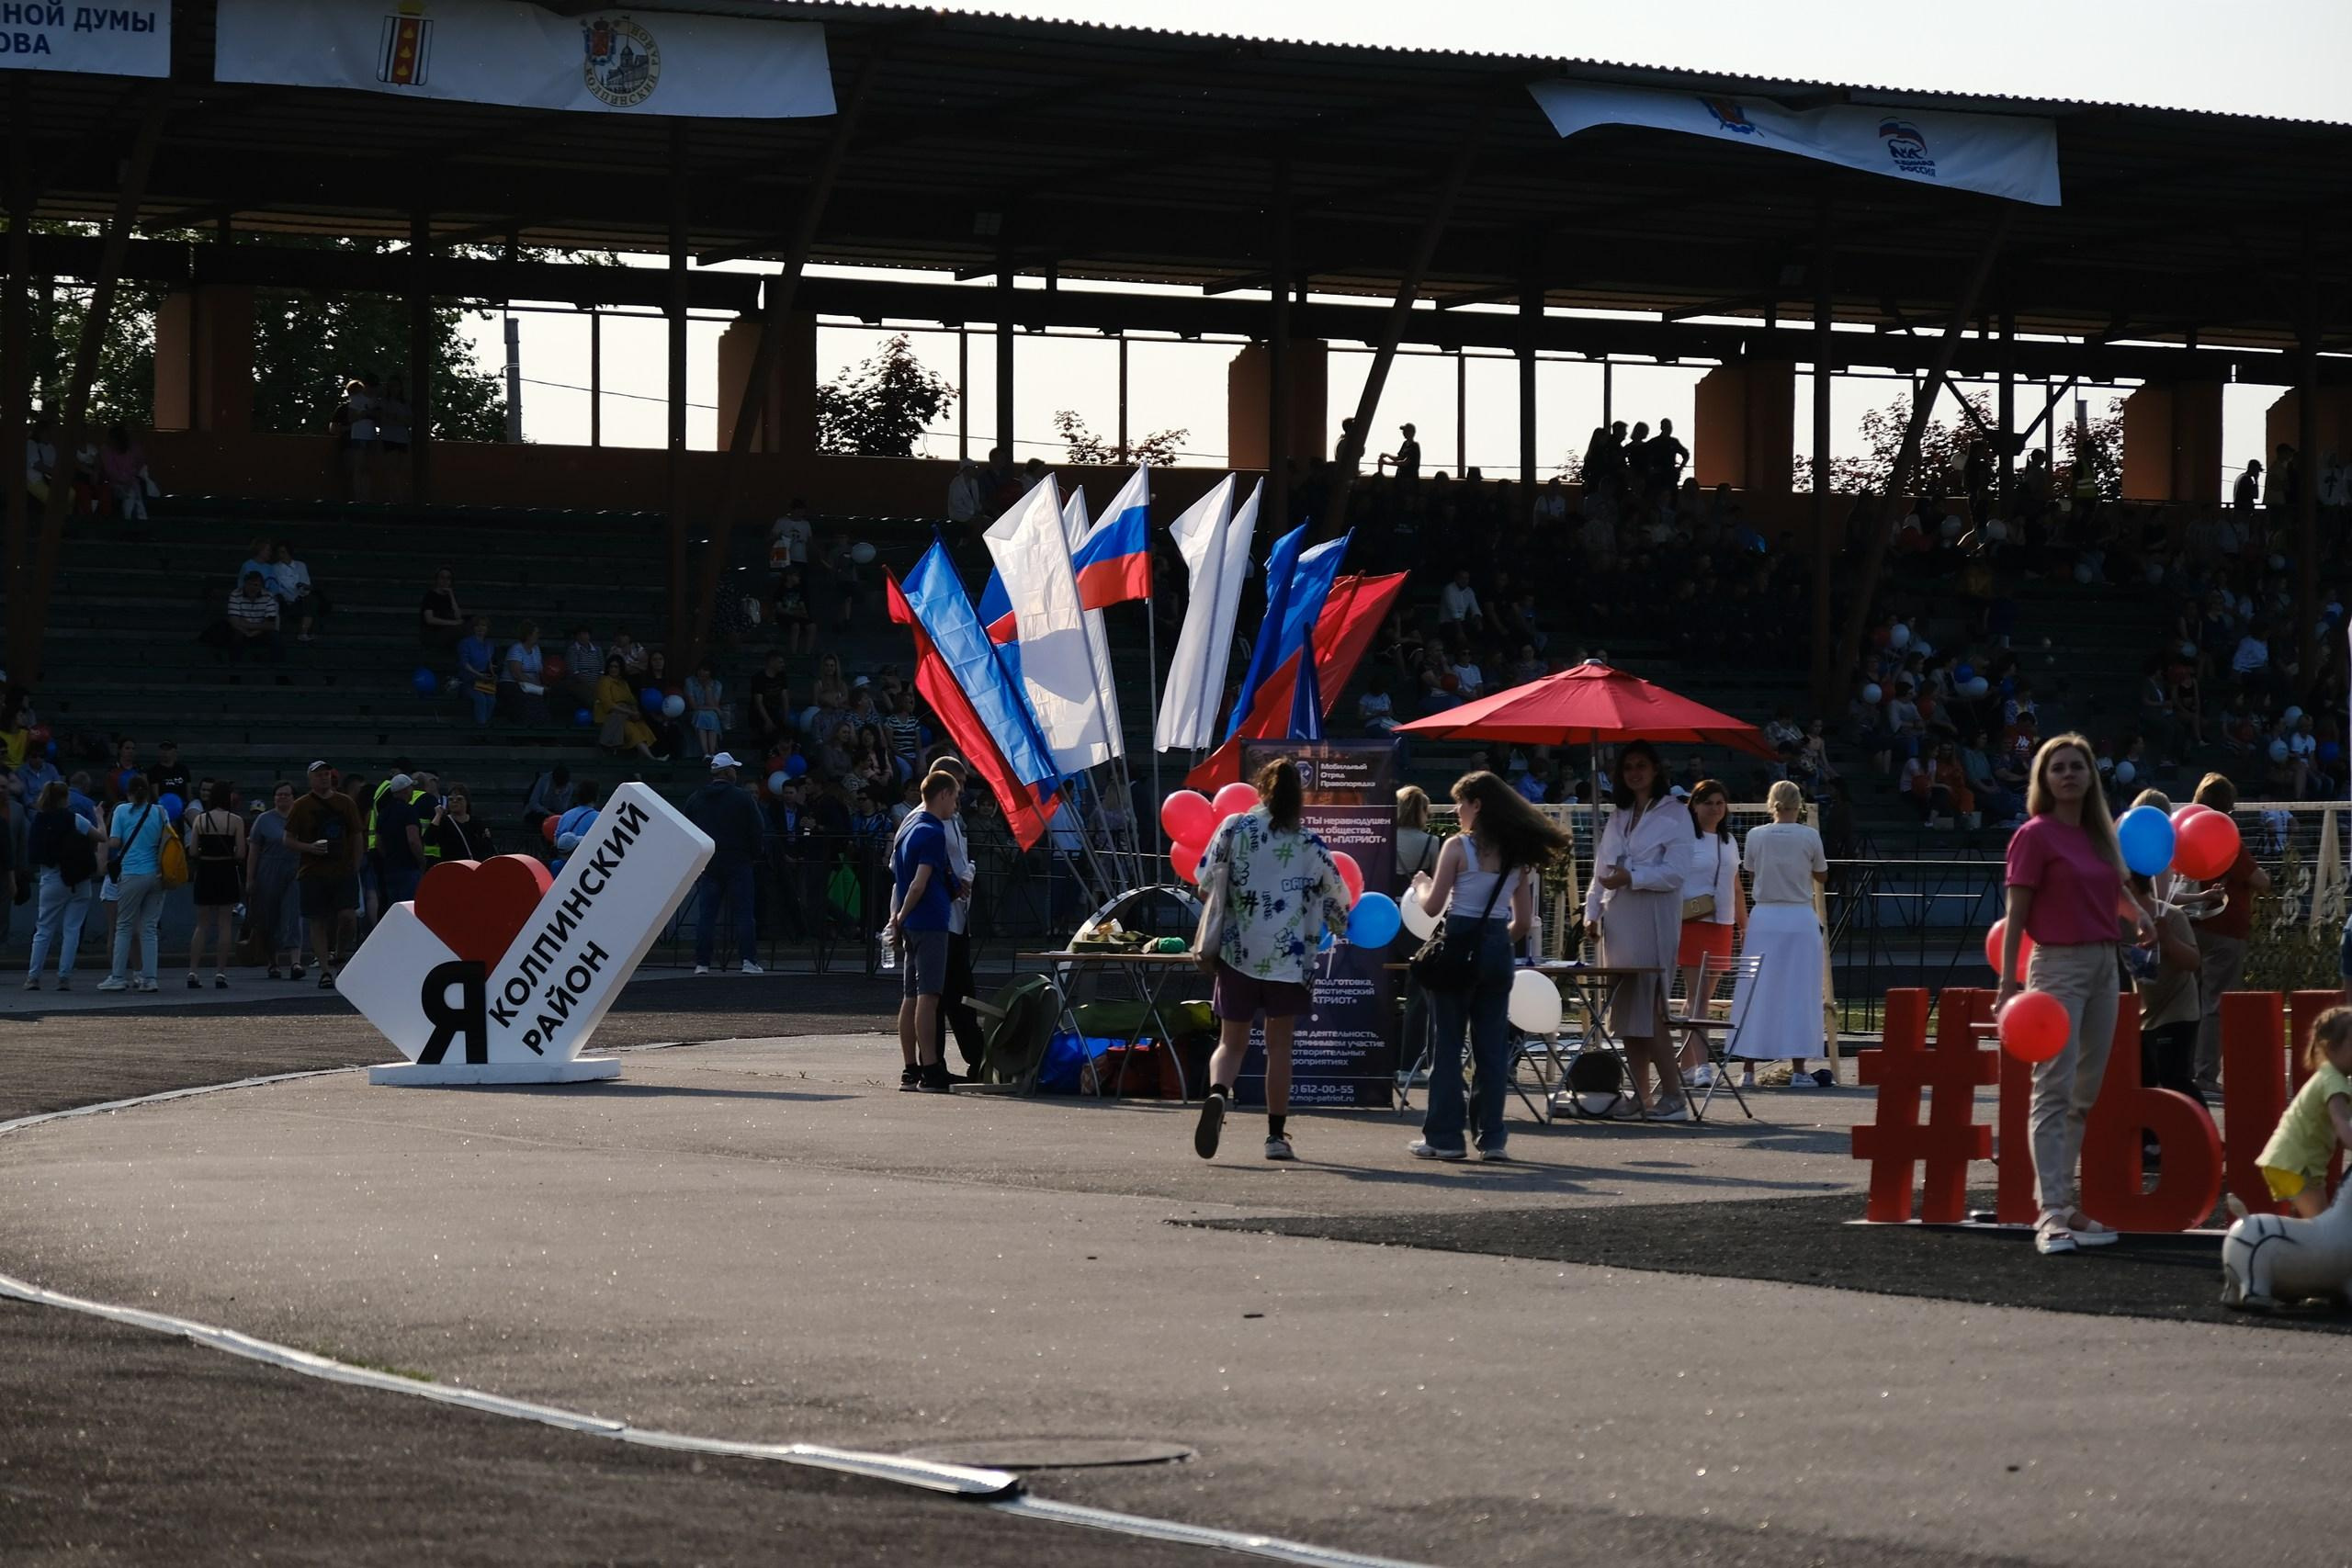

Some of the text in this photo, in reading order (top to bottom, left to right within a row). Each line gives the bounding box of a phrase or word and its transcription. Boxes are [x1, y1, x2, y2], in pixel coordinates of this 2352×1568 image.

[74, 7, 154, 32] ДУМЫ
[1320, 780, 1376, 788] Правопорядка
[1323, 818, 1391, 826] неравнодушен
[1325, 826, 1374, 835] общества,
[489, 800, 650, 1029] КОЛПИНСКИЙ
[1315, 978, 1374, 987] подготовка,
[1313, 987, 1375, 996] риотический
[522, 939, 610, 1056] РАЙОН
[416, 960, 488, 1065] Я
[1308, 1031, 1379, 1039] деятельность,
[1294, 1040, 1347, 1048] принимаем
[1300, 1085, 1354, 1094] 612-00-55
